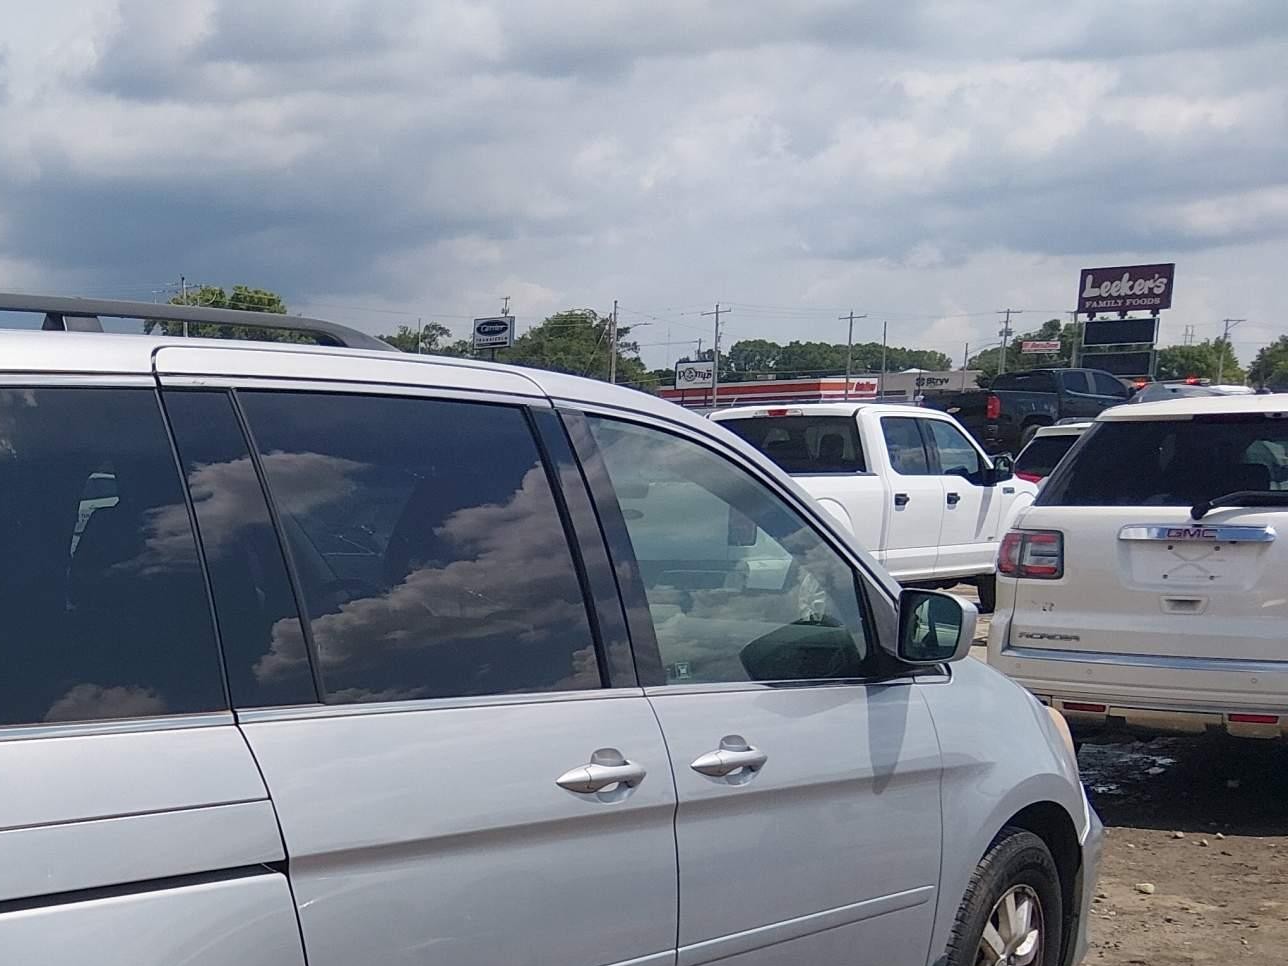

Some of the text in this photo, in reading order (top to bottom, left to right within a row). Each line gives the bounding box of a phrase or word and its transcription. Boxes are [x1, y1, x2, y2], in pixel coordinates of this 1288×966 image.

[1082, 272, 1168, 298] Leeker's
[1084, 297, 1161, 308] FAMILY FOODS
[1166, 528, 1218, 538] GMC
